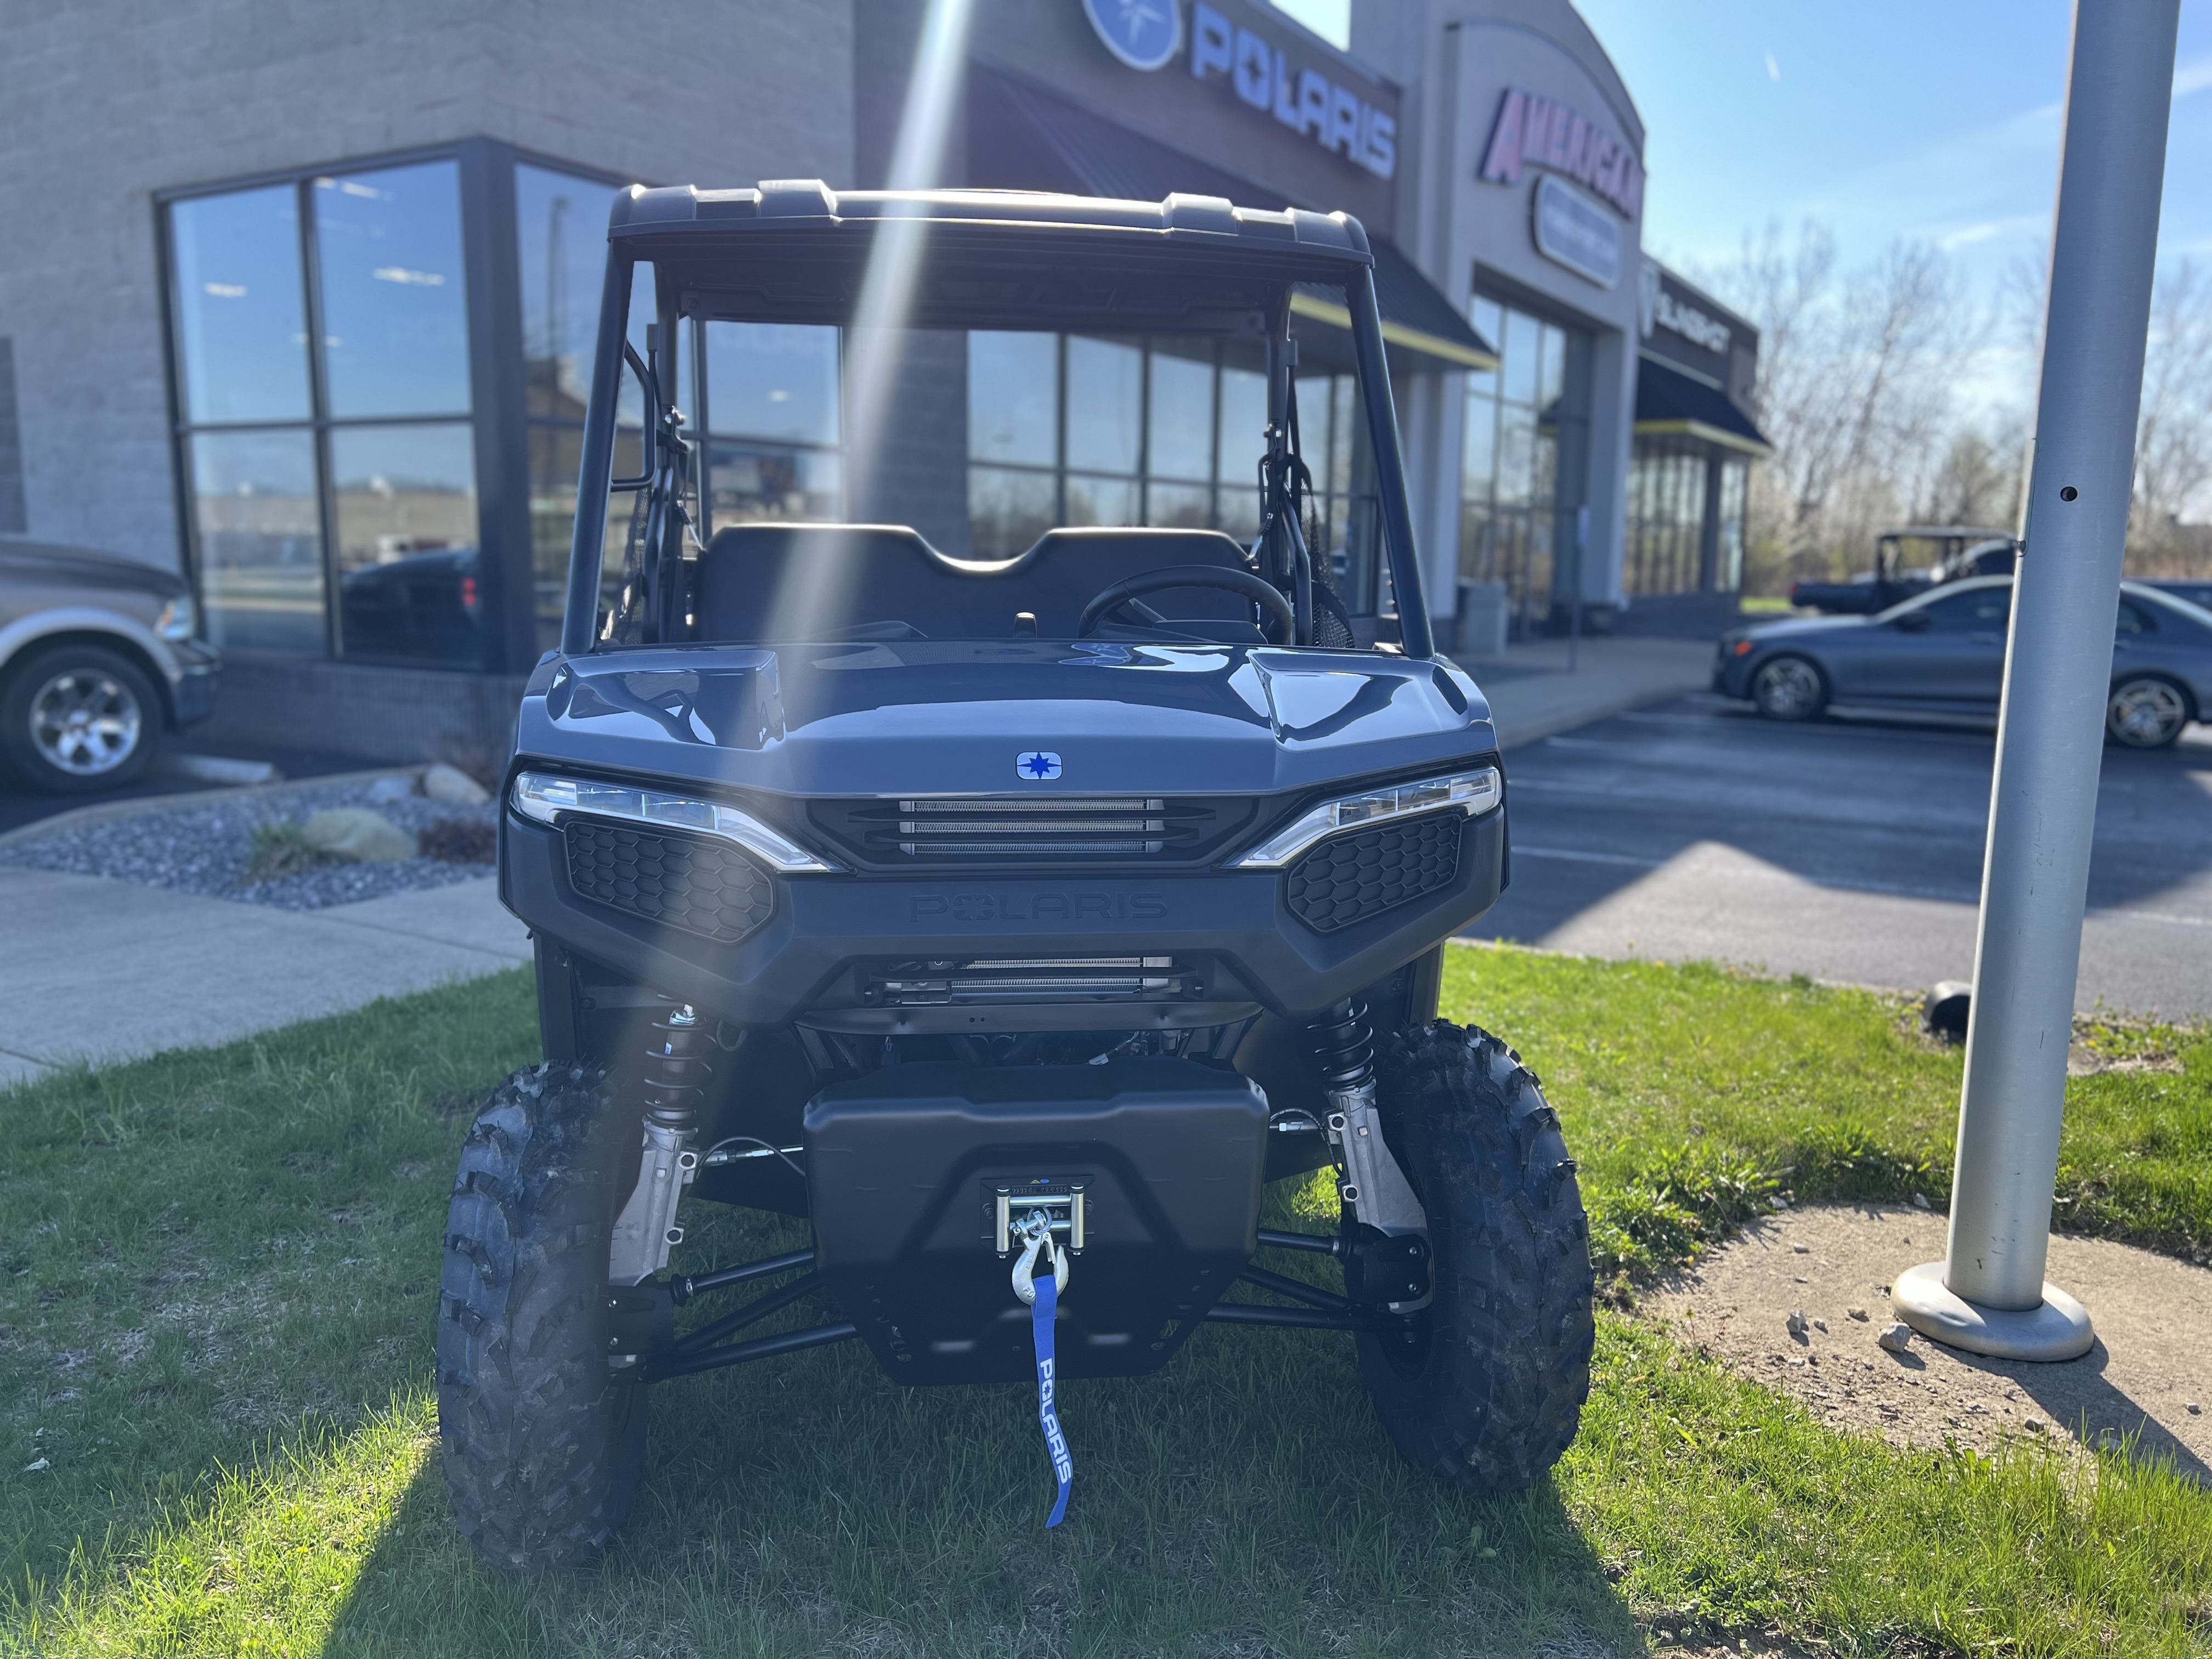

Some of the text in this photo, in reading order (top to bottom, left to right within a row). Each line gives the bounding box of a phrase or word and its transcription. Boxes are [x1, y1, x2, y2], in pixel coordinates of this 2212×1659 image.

[1192, 2, 1396, 179] POLARIS
[910, 891, 1168, 922] POLARIS
[1040, 1358, 1071, 1484] POLARIS
